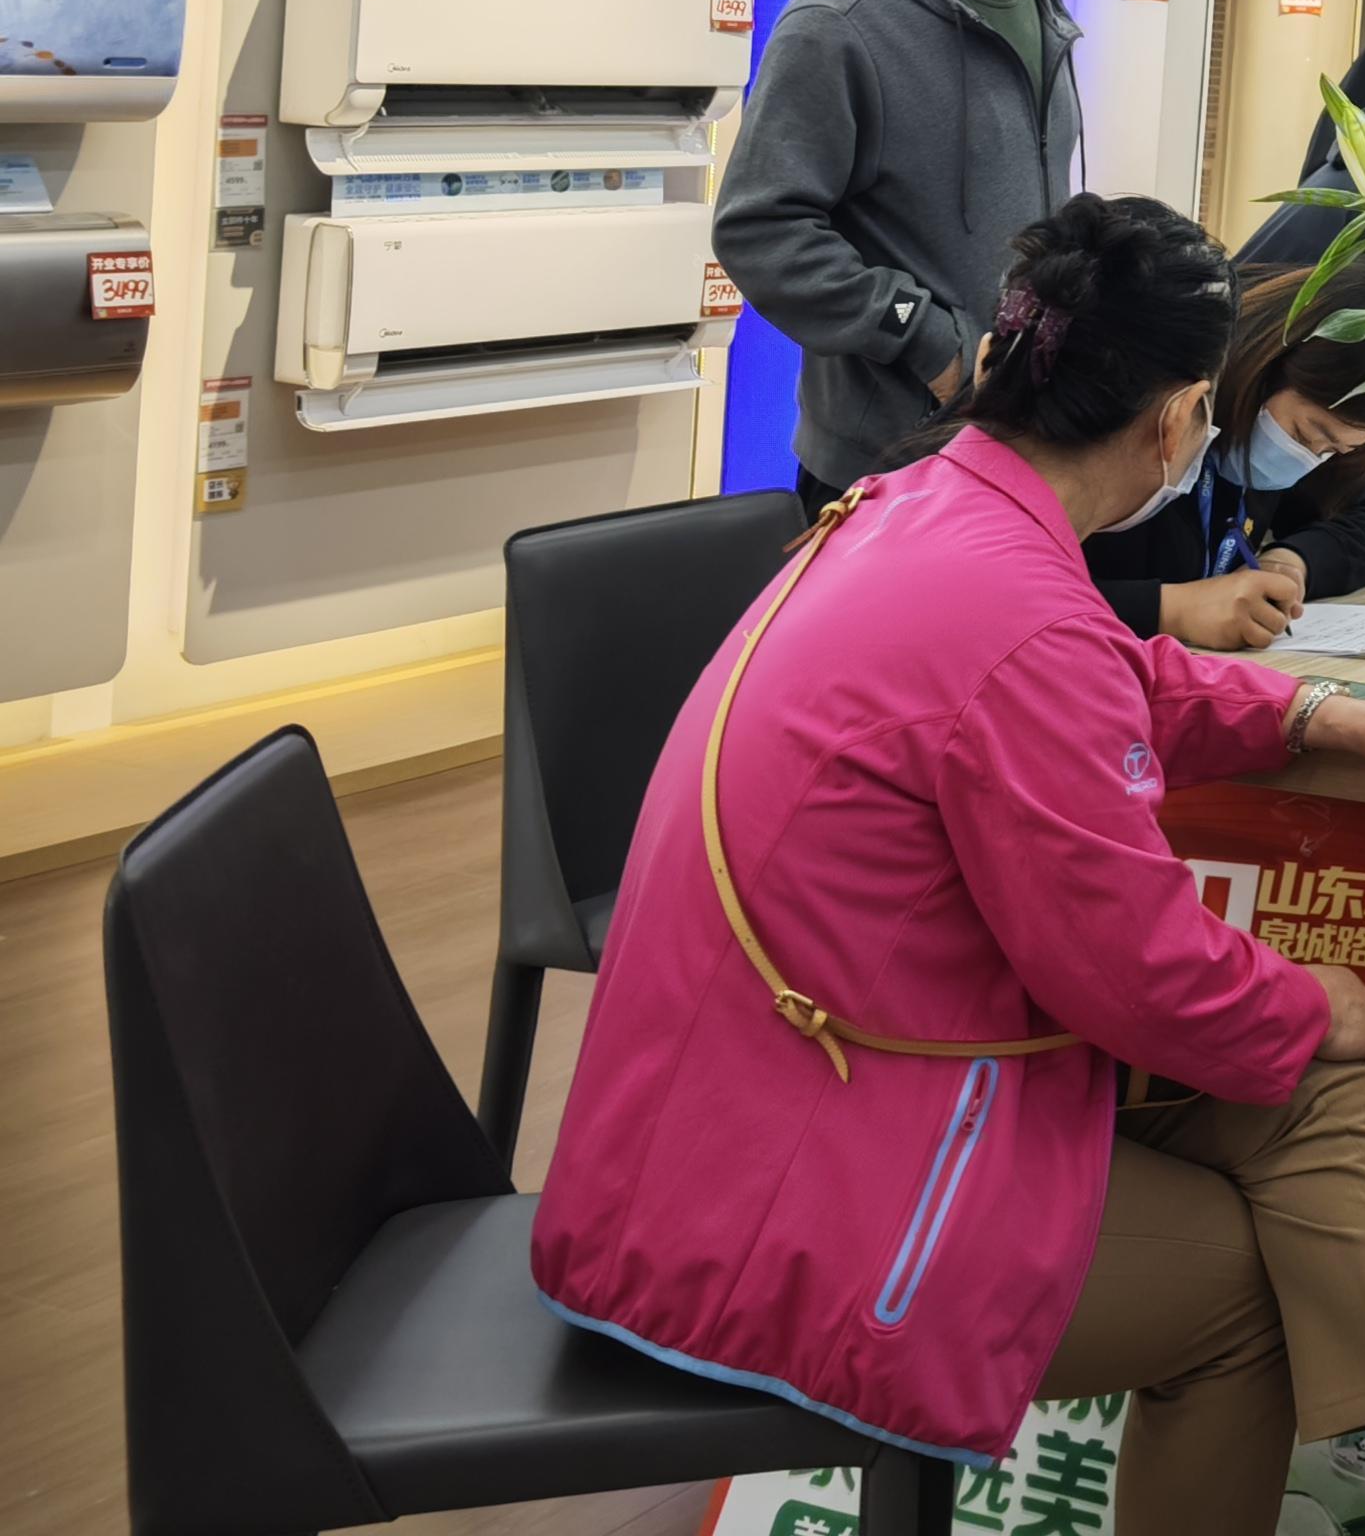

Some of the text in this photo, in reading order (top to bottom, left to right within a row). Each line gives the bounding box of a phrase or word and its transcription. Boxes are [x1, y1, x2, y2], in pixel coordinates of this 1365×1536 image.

[91, 254, 151, 271] 开业专享价
[102, 279, 150, 302] 3499
